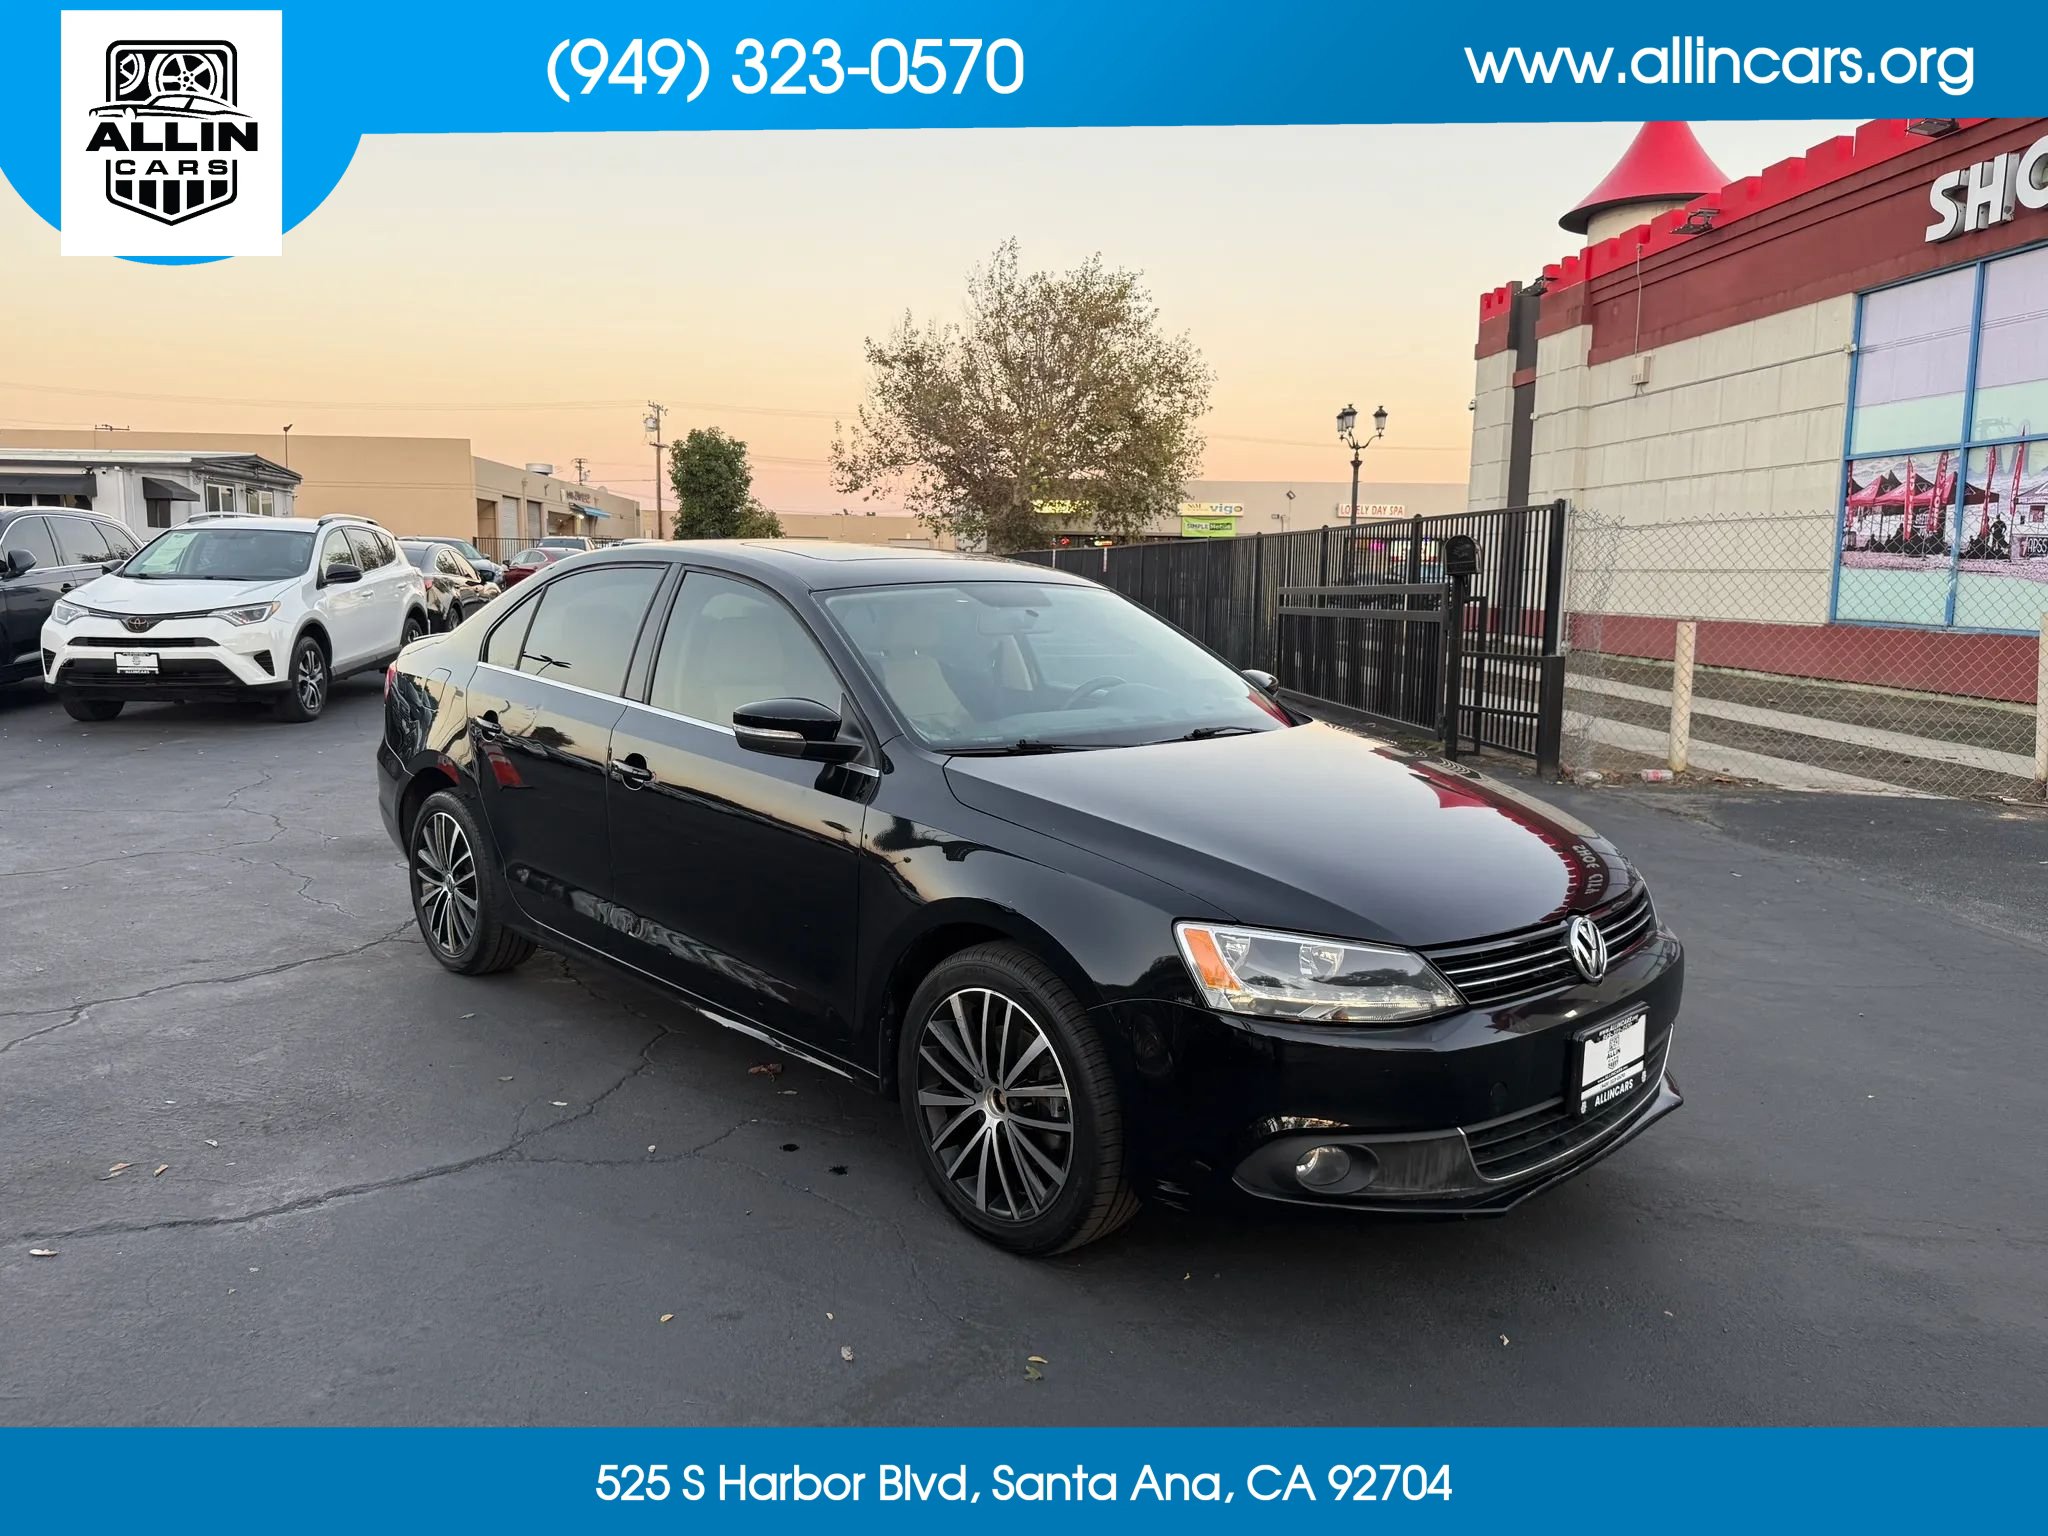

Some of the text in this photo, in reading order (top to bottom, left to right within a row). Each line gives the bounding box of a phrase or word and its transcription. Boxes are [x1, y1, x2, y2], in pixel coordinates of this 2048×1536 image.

[1210, 504, 1243, 514] vigo
[1340, 505, 1403, 516] LOELY DAY SPA
[1594, 1079, 1634, 1107] ALLINCARS
